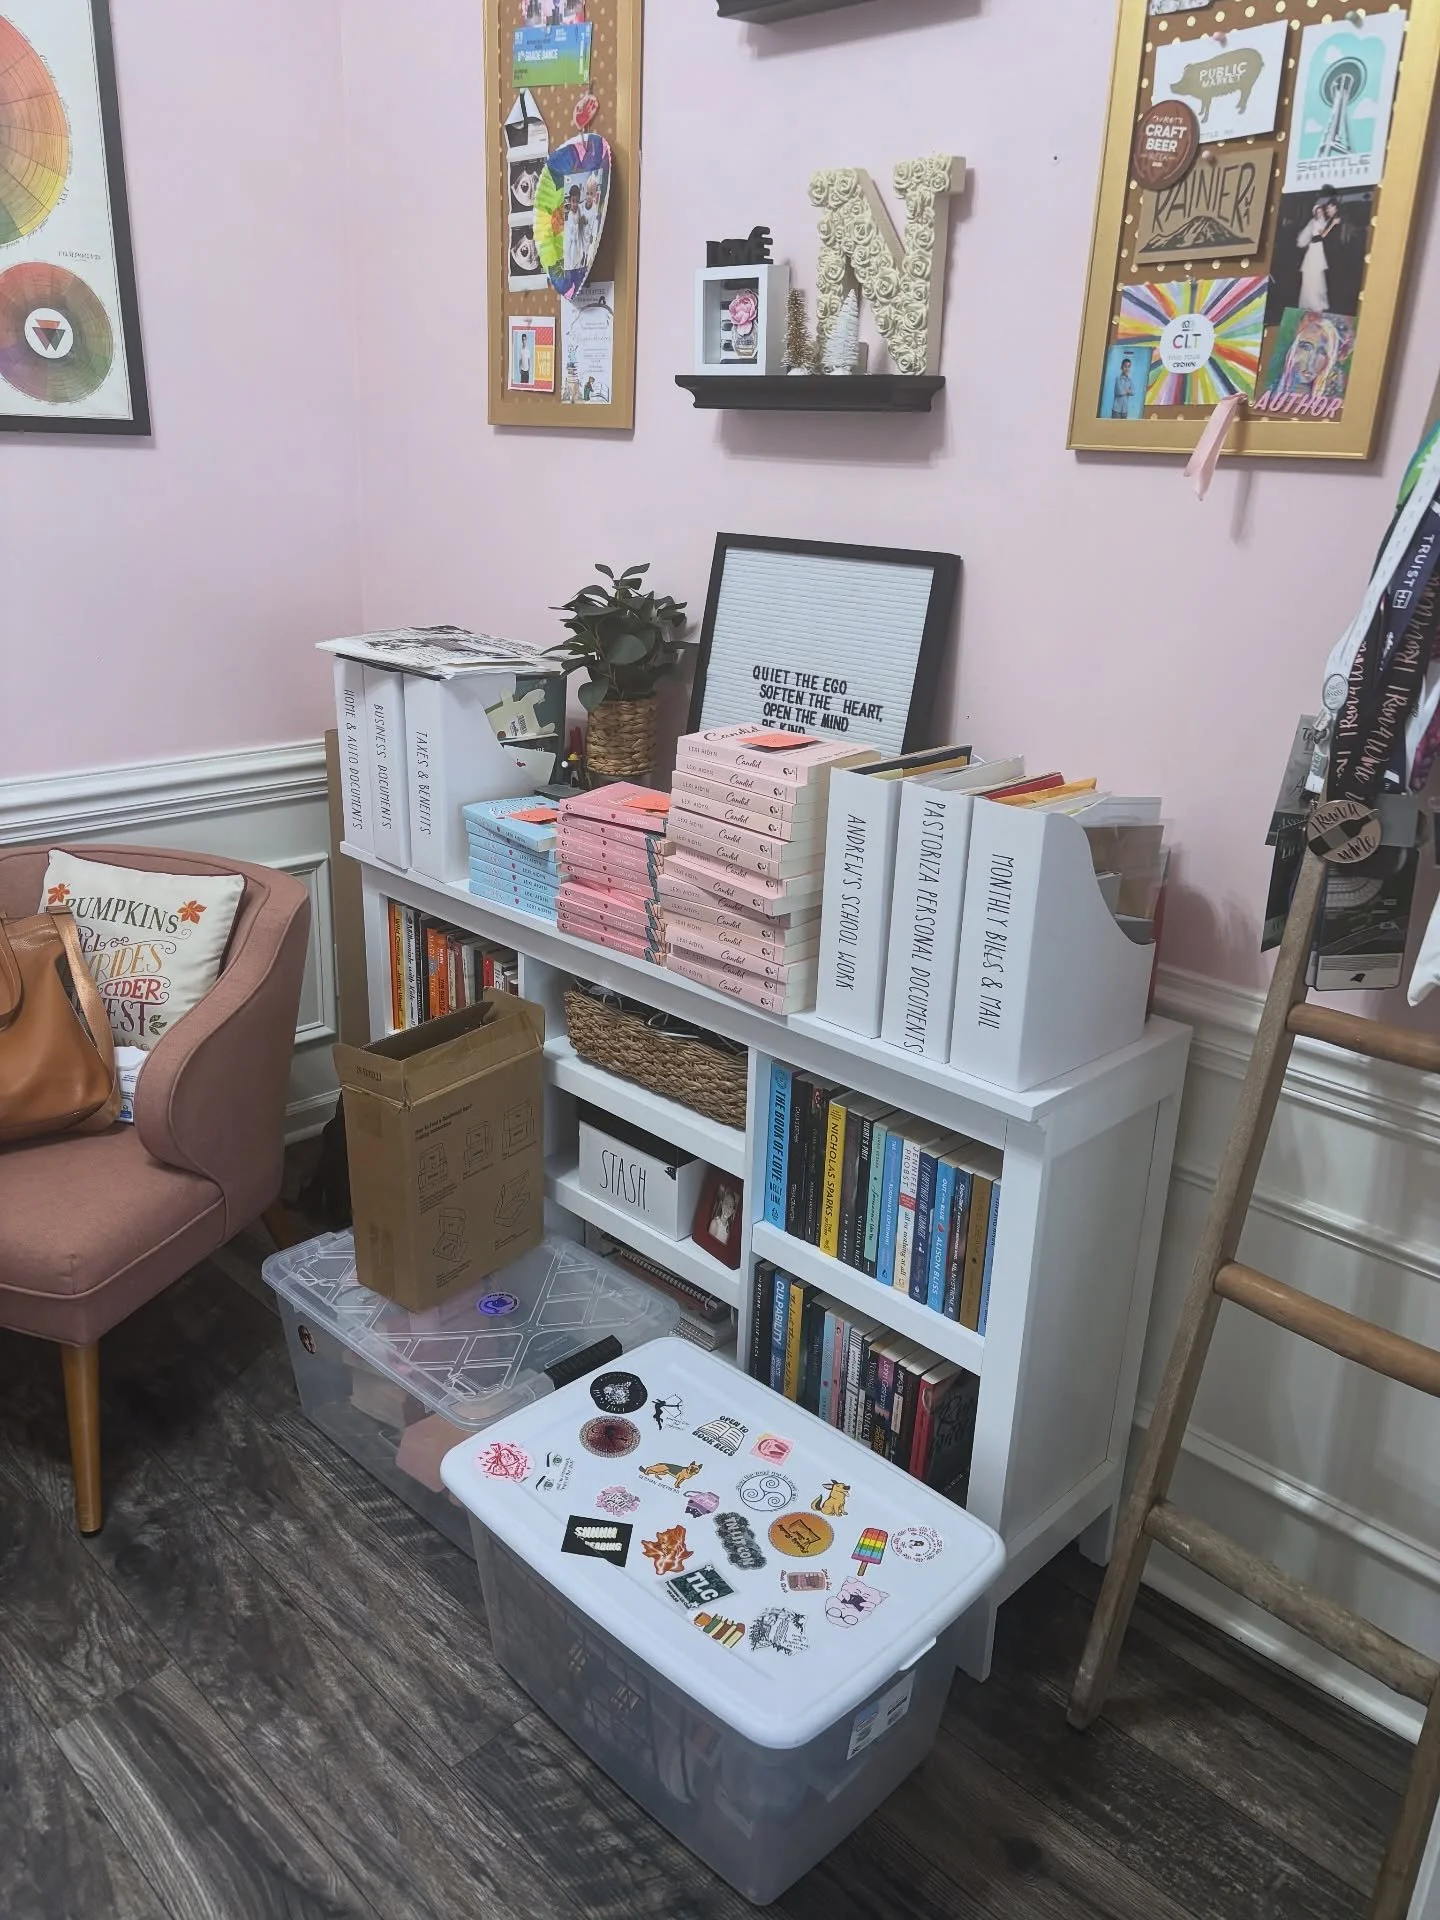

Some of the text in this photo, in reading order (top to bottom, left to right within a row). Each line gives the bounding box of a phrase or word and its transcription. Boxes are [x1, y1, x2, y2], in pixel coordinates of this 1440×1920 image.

[1200, 62, 1247, 78] PUBLIC
[1202, 74, 1242, 88] MARKET
[1145, 124, 1187, 138] CRAFT
[1146, 138, 1178, 152] BEER
[1297, 154, 1371, 172] SEATTLE
[1151, 162, 1256, 233] RAINIER
[1172, 333, 1202, 350] CLT
[1255, 390, 1343, 418] AUTHOR
[1404, 534, 1435, 588] TRUIST
[753, 665, 847, 695] QUIET THE EGO
[759, 685, 884, 722] SOFTEN THE HEART,
[763, 702, 849, 732] OPEN THE MIND
[344, 689, 363, 830] HOME & AUTO DOCUMENTS
[373, 703, 392, 830] BUSINESS DOCUMENTS
[735, 754, 762, 769] Candid
[415, 731, 431, 835] TAXES & BENEFITS
[730, 773, 754, 788] Candid
[725, 791, 750, 806] Candid
[724, 809, 750, 824] Candid
[718, 828, 742, 844] Candid
[716, 846, 740, 862] Candid
[713, 881, 736, 897] Candid
[65, 897, 179, 934] PUMPKINS
[718, 899, 743, 912] Candid
[835, 813, 867, 992] ANDREW'S SCHOOL WORK
[716, 915, 742, 930] Candid
[903, 799, 947, 1054] PASTORIZA PERSONAL DOCUMENTS
[718, 931, 742, 947] Candid
[978, 853, 1014, 1031] MONTHLY BILLS & MAIL
[720, 950, 746, 965] Candid
[104, 979, 162, 1000] CIDER
[718, 979, 743, 995] Candid
[775, 1089, 786, 1112] THE
[774, 1111, 785, 1141] BOOK
[772, 1140, 784, 1156] OF
[771, 1154, 783, 1183] LOVE
[825, 1122, 839, 1217] NICHOLAS SPARKS
[903, 1148, 911, 1187] PROBST
[909, 1146, 919, 1194] JENNIFER
[900, 1231, 908, 1258] nothing
[932, 1236, 943, 1295] ALISON BLISS
[773, 1281, 785, 1347] CULPABILITY
[720, 1416, 749, 1433] OPEN TO
[863, 1411, 873, 1440] SHACK
[692, 1431, 735, 1456] BOOK RECS
[686, 1571, 719, 1601] TLC
